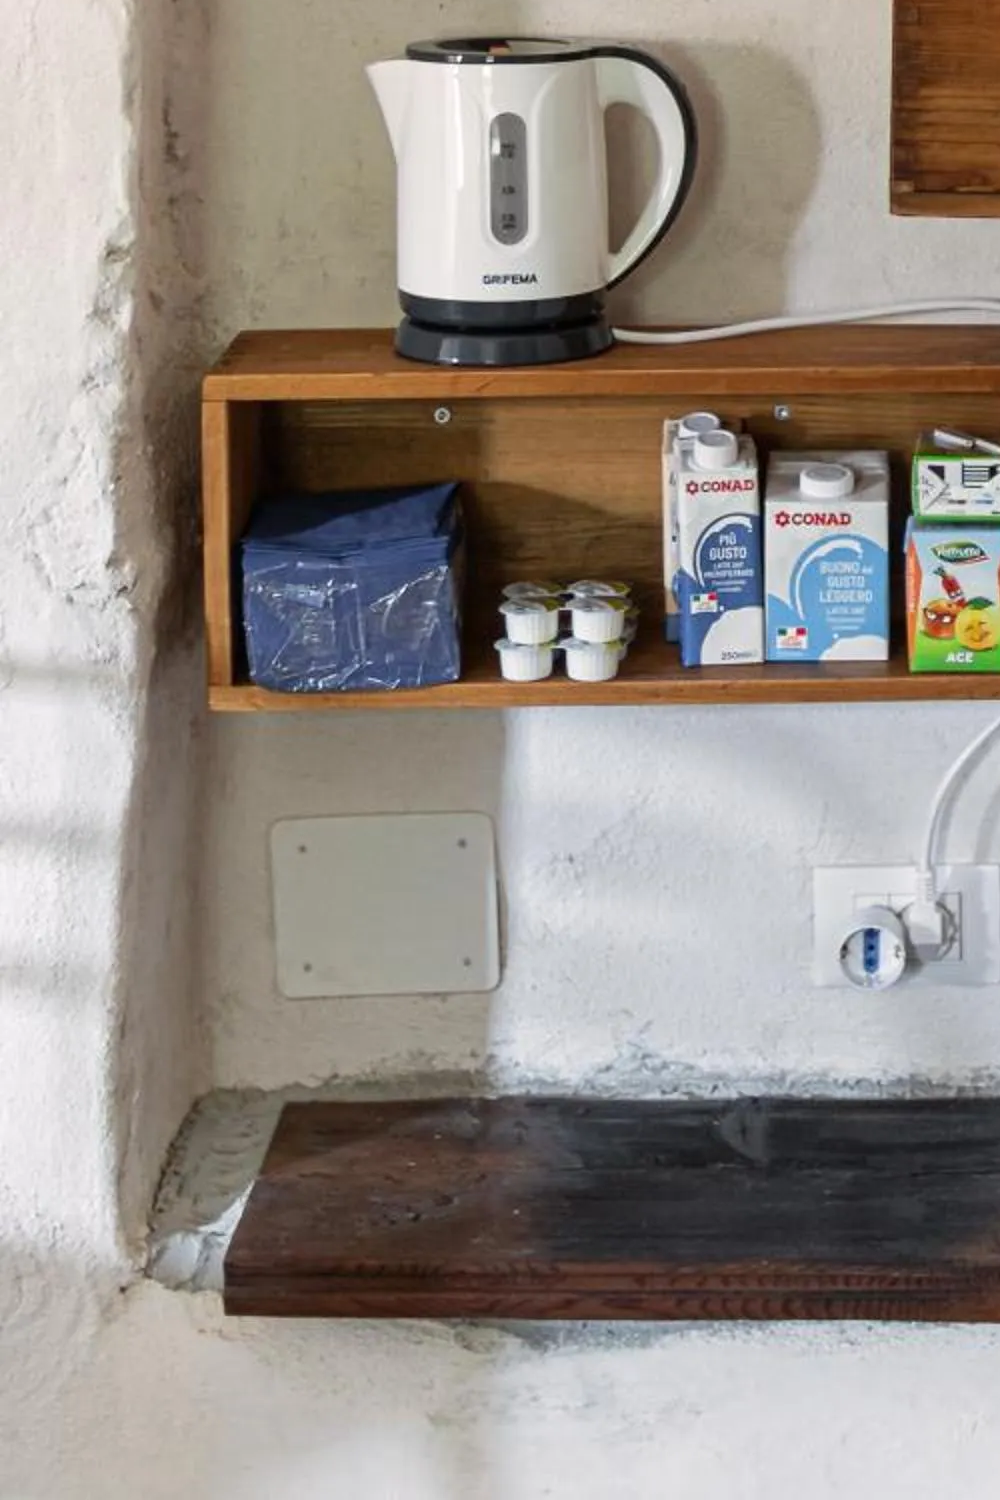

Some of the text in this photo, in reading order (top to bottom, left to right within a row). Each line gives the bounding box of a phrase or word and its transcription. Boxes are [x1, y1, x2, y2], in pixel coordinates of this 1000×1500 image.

[483, 274, 538, 285] GRIFEMA
[701, 479, 755, 493] CONAD
[791, 512, 851, 526] CONAD
[709, 546, 747, 561] GUSTO
[820, 561, 860, 575] BUONO
[827, 575, 865, 589] GUSTO
[819, 590, 873, 604] LEGGERO
[945, 651, 974, 663] ACE
